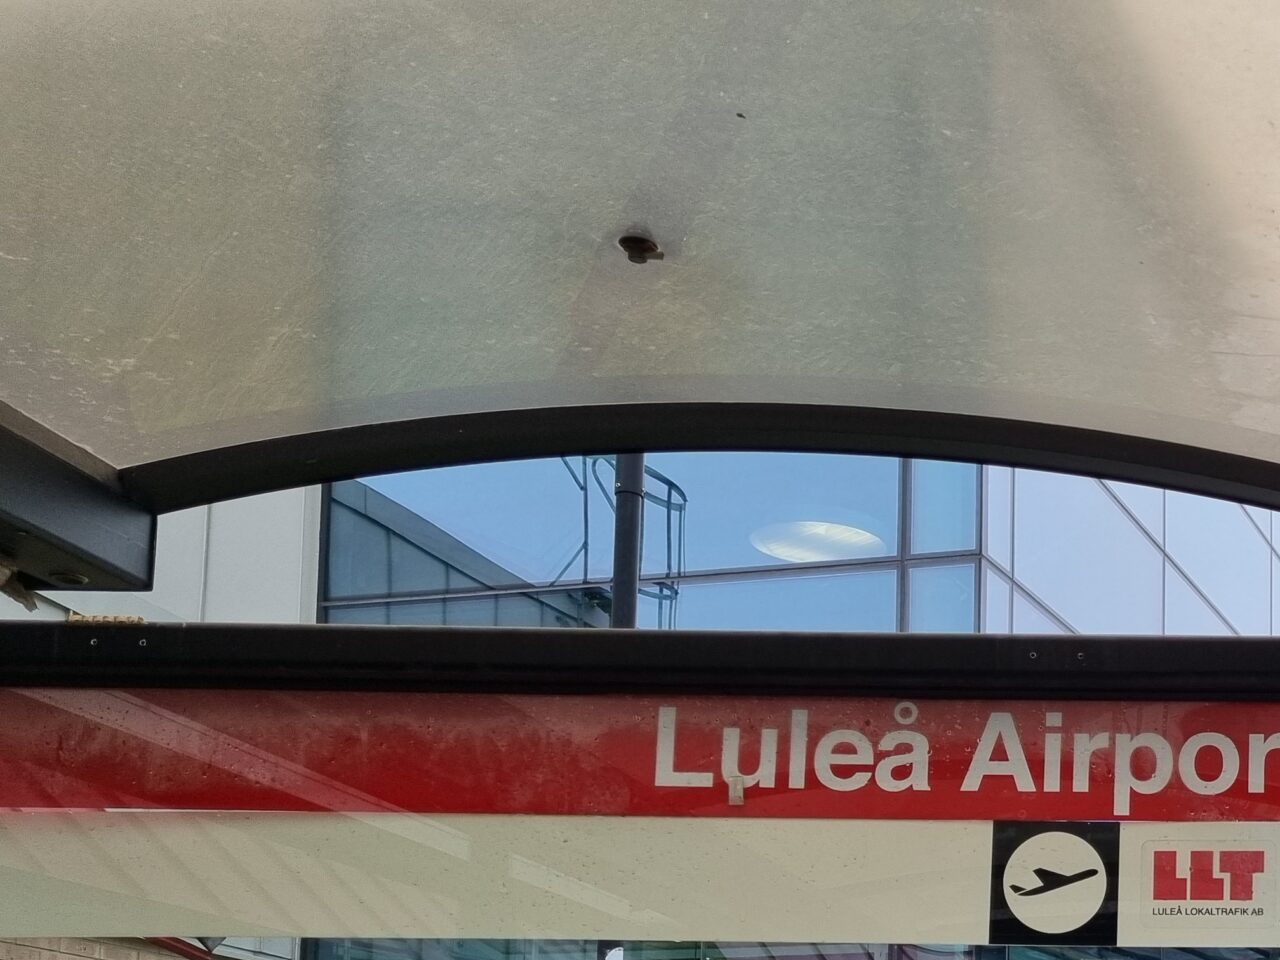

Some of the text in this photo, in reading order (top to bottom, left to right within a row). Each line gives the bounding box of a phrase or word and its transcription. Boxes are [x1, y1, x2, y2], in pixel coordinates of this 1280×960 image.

[654, 701, 931, 793] Luleå
[1153, 850, 1265, 901] LLT
[1152, 905, 1264, 916] LULEÅ LOKALTRAFIK AB
